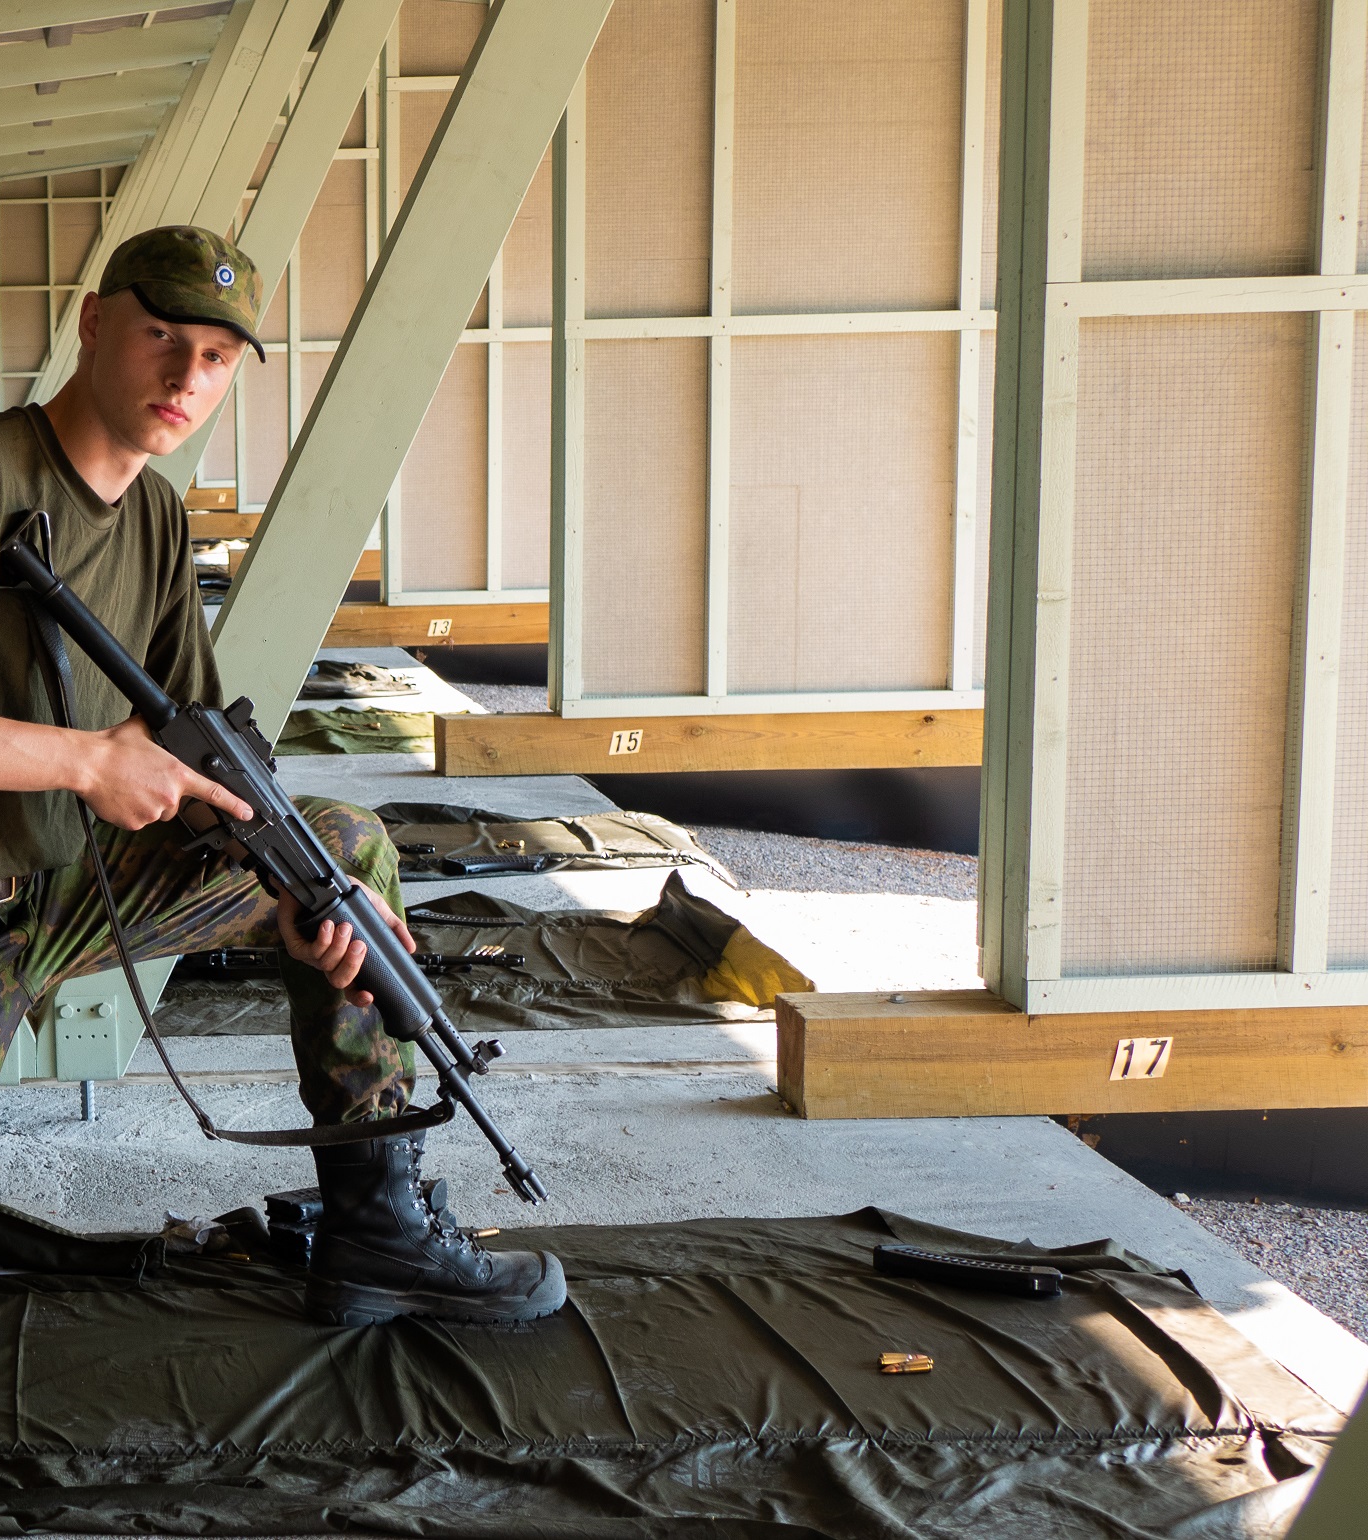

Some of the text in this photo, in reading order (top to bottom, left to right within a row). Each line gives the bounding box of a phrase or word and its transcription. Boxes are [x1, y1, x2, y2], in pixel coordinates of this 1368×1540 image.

[432, 620, 449, 635] 13
[615, 731, 639, 752] 15
[1121, 1040, 1168, 1078] 17
